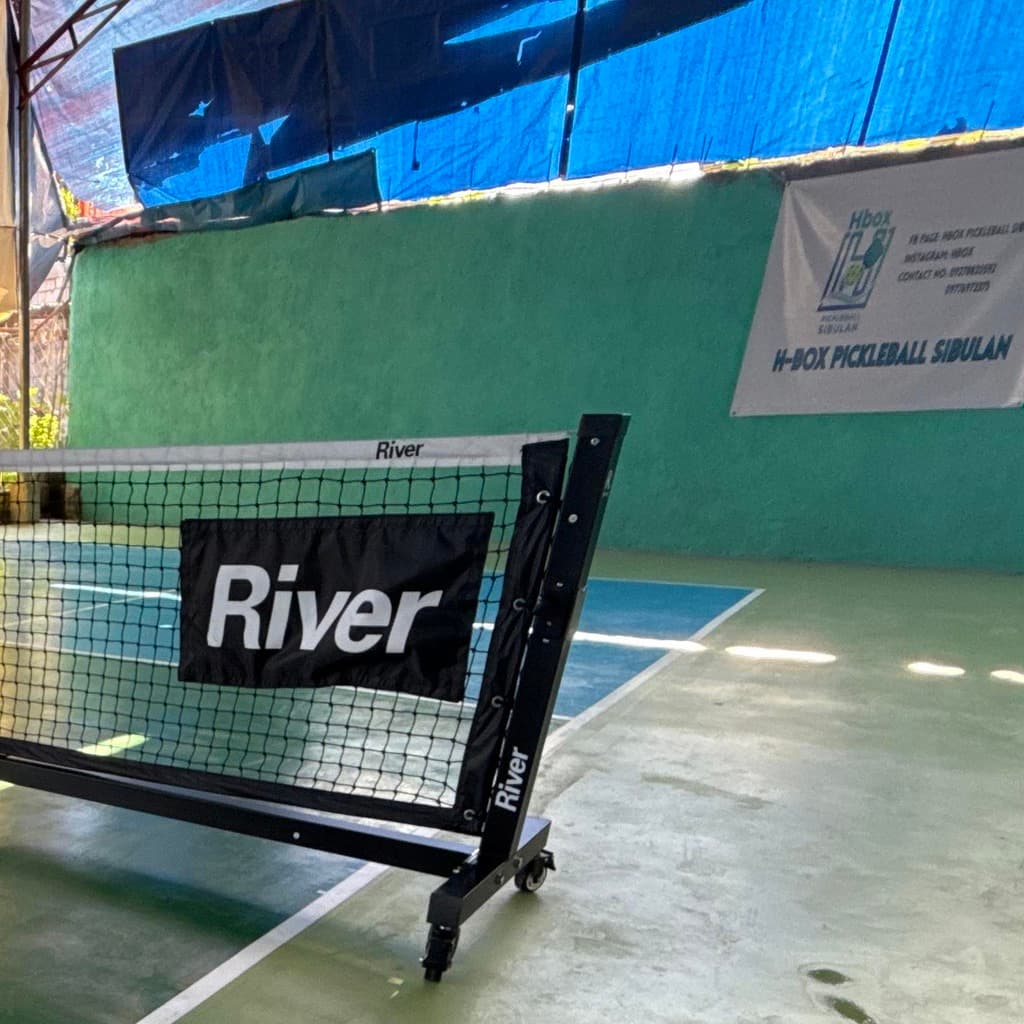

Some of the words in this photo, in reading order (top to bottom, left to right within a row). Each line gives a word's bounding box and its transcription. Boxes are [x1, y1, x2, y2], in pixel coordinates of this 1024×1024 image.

[848, 208, 893, 230] Hbox
[772, 345, 830, 372] H-BOX
[830, 340, 928, 369] PICKLEBALL
[931, 334, 1014, 363] SIBULAN
[376, 441, 424, 460] River
[207, 564, 443, 654] River
[495, 746, 528, 812] River
